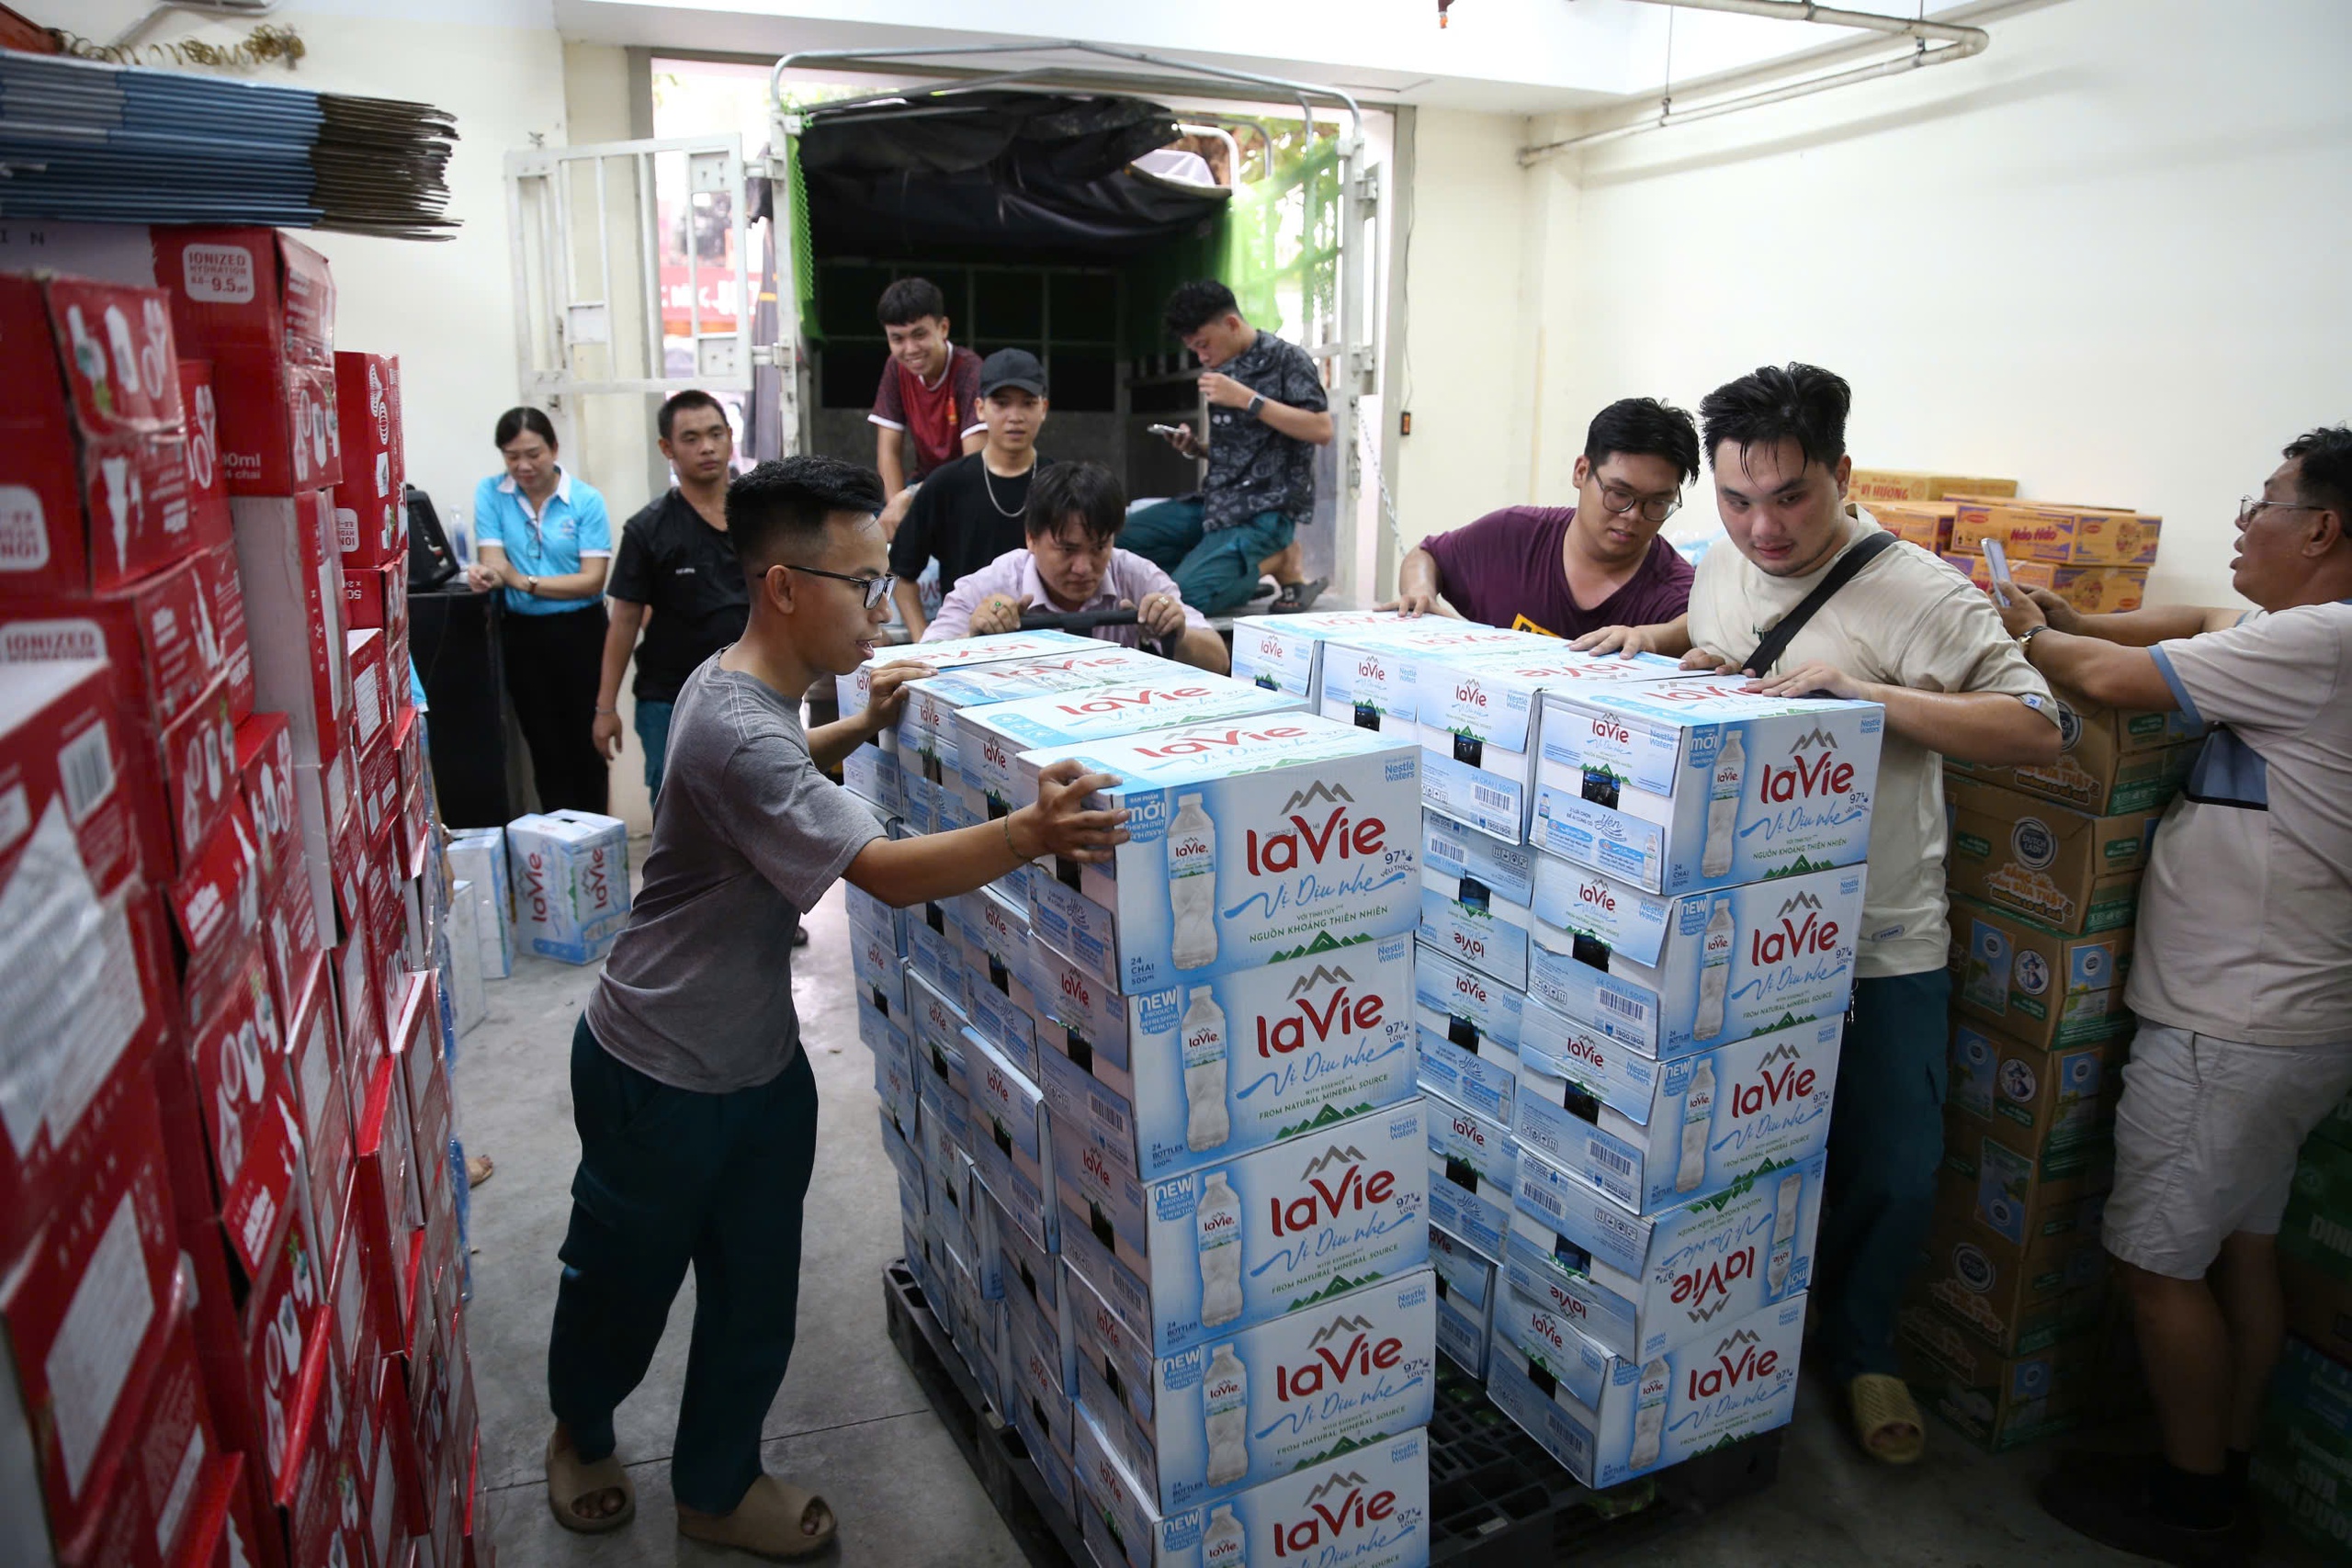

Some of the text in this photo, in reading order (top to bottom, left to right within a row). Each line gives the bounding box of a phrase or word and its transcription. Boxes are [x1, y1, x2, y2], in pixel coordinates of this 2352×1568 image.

[188, 250, 246, 267] IONIZED
[1261, 639, 1283, 660] laVie
[1358, 661, 1385, 683] laVie
[1056, 687, 1213, 716] laVie
[1455, 685, 1487, 710] laVie
[1132, 727, 1309, 759] laVie
[1592, 719, 1630, 744] laVie
[1649, 737, 1675, 752] Waters
[983, 743, 1006, 768] laVie
[1385, 761, 1415, 774] Nestlé
[1385, 771, 1415, 783] Waters
[1717, 772, 1739, 783] laVie
[1760, 751, 1854, 805] laVie
[1175, 841, 1208, 857] laVie
[1247, 807, 1386, 877] laVie
[1752, 837, 1848, 861] NGUỒN KHOÁNG THIÊN NHIÊN
[2021, 834, 2047, 848] DUTCH
[2024, 841, 2044, 855] LADY
[591, 847, 608, 911] laVie
[1673, 869, 1690, 879] CHAI
[529, 852, 548, 924] laVie
[1578, 883, 1616, 913] laVie
[985, 906, 1008, 935] laVie
[1640, 900, 1665, 918] Nestlé
[1250, 905, 1388, 944] NGUỒN KHOÁNG THIÊN NHIÊN
[1378, 942, 1405, 956] Nestlé
[1453, 931, 1486, 959] laVie
[1708, 939, 1729, 952] laVie
[1752, 912, 1838, 966] laVie
[1131, 957, 1142, 966] 24
[1131, 963, 1155, 976] CHAI
[1061, 966, 1091, 1009] laVie
[1455, 976, 1487, 1004] laVie
[1743, 1009, 1759, 1020] FROM
[1759, 1002, 1783, 1015] NATURAL
[1809, 990, 1833, 1004] SOURCE
[1256, 987, 1385, 1058] laVie
[1189, 1032, 1219, 1049] laVie
[1616, 1028, 1645, 1047] 1900 1906
[1567, 1038, 1604, 1068] laVie
[1626, 1061, 1651, 1078] Nestlé
[1626, 1070, 1650, 1087] Waters
[987, 1070, 1009, 1102] laVie
[1259, 1073, 1389, 1121] FROM NATURAL MINERAL SOURCE
[1732, 1062, 1816, 1119] laVie
[1690, 1096, 1711, 1109] laVie
[1389, 1118, 1418, 1134] Nestlé
[1390, 1127, 1418, 1142] Waters
[1453, 1117, 1485, 1147] laVie
[1152, 1145, 1184, 1161] BOTTLES
[1724, 1158, 1740, 1169] FROM
[1741, 1151, 1764, 1165] NATURAL
[1787, 1134, 1810, 1150] SOURCE
[1082, 1148, 1111, 1188] laVie
[1271, 1165, 1396, 1237] laVie
[1204, 1215, 1235, 1233] laVie
[1272, 1244, 1399, 1295] FROM NATURAL MINERAL SOURCE
[1669, 1247, 1755, 1308] laVie
[1550, 1285, 1588, 1320] laVie
[1096, 1307, 1121, 1346] laVie
[1532, 1313, 1563, 1349] laVie
[1277, 1333, 1402, 1402] laVie
[1689, 1345, 1779, 1401] laVie
[1210, 1383, 1240, 1400] laVie
[1643, 1382, 1663, 1395] laVie
[1277, 1404, 1407, 1455] FROM NATURAL MINERAL SOURCE
[1274, 1488, 1396, 1558] laVie
[1209, 1544, 1238, 1559] laVie
